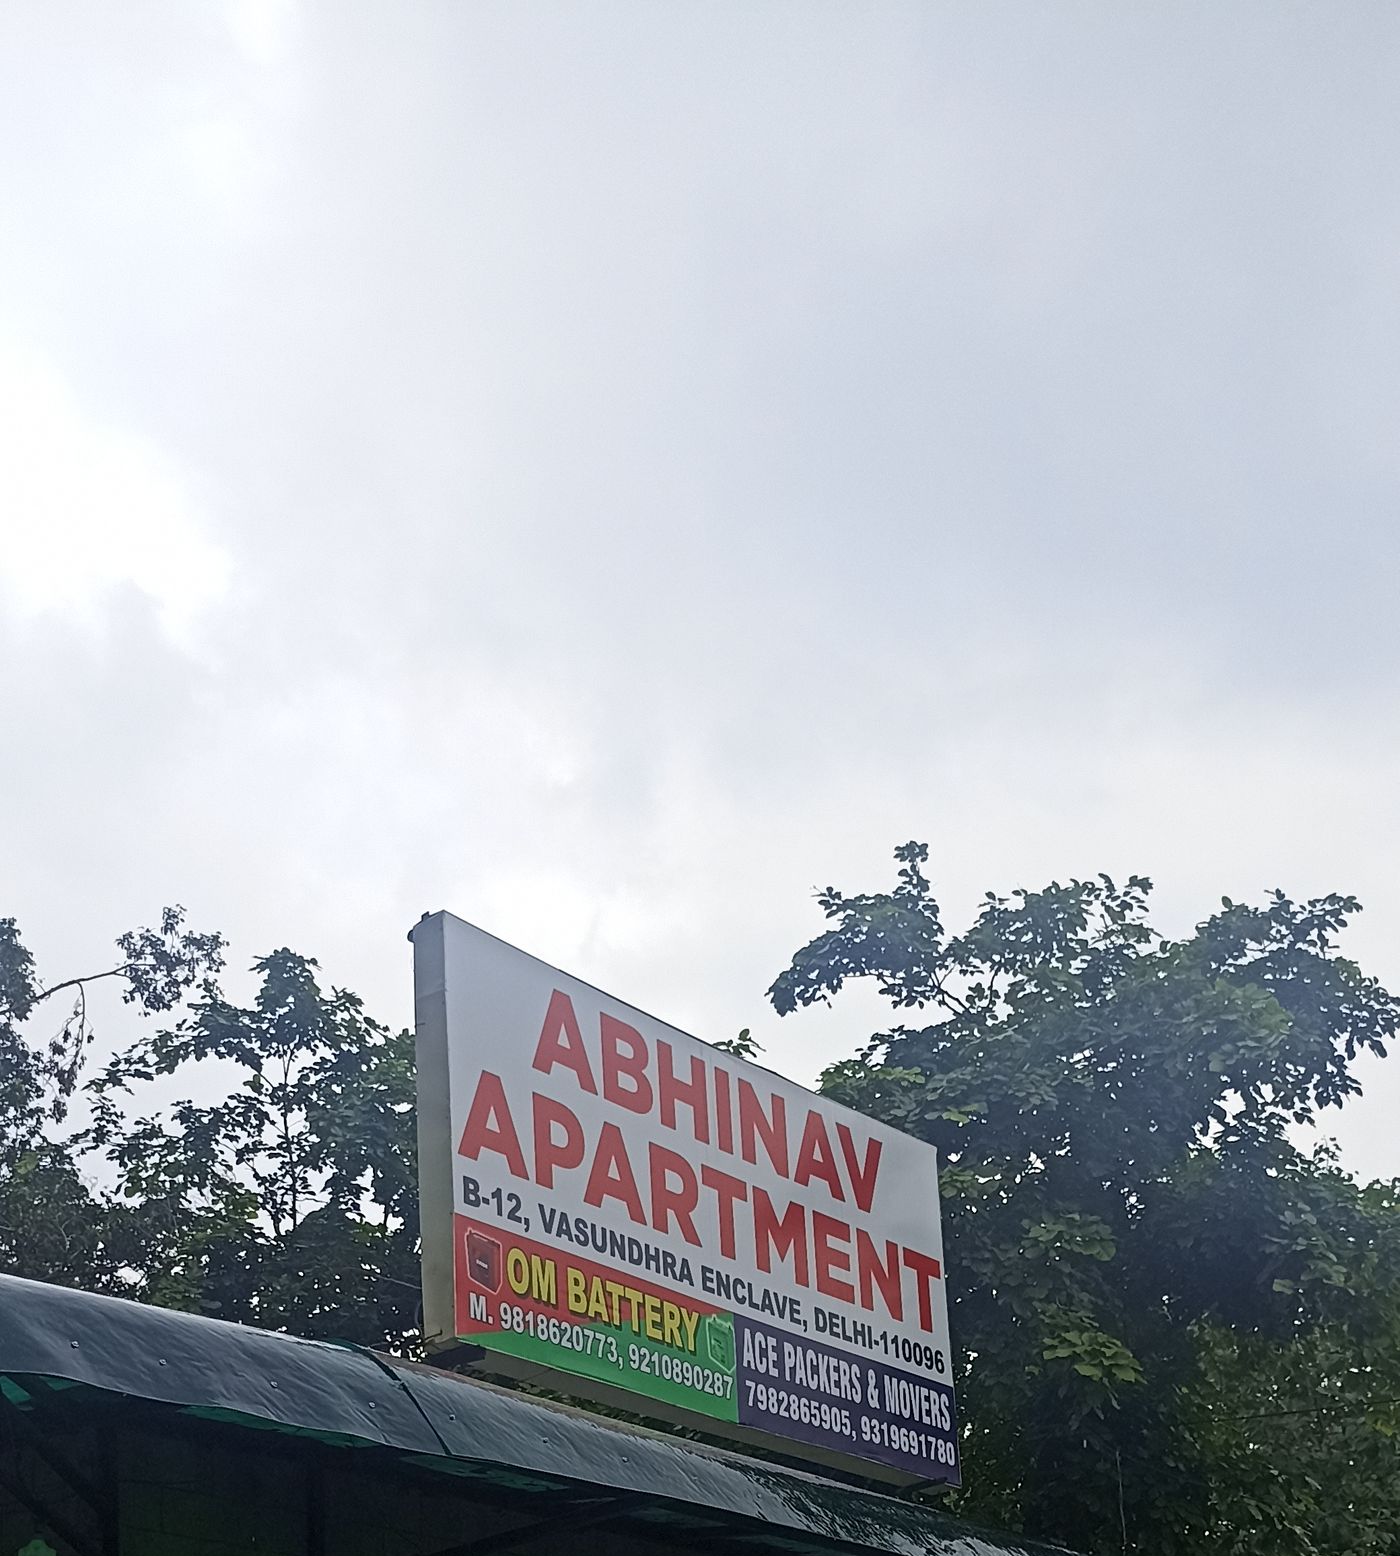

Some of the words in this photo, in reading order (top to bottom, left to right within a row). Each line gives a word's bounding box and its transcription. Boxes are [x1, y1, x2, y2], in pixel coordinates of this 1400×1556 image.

[532, 988, 883, 1214] ABHINAV
[458, 1069, 941, 1333] APARTMENT
[462, 1175, 531, 1233] B-12,
[537, 1203, 695, 1287] VASUNDHRA
[701, 1265, 808, 1333] ENCLAVE,
[814, 1306, 945, 1374] DELHI-110096
[506, 1247, 557, 1305] OM
[567, 1266, 700, 1353] BATTERY
[469, 1292, 494, 1325] M.
[499, 1302, 624, 1371] 9818620773,
[628, 1343, 734, 1400] 9210890287
[743, 1327, 779, 1378] ACE
[784, 1341, 862, 1404] PACKERS
[867, 1368, 881, 1410] &
[884, 1374, 951, 1432] MOVERS
[745, 1379, 858, 1442] 7982865905,
[860, 1415, 956, 1467] 9319691780
